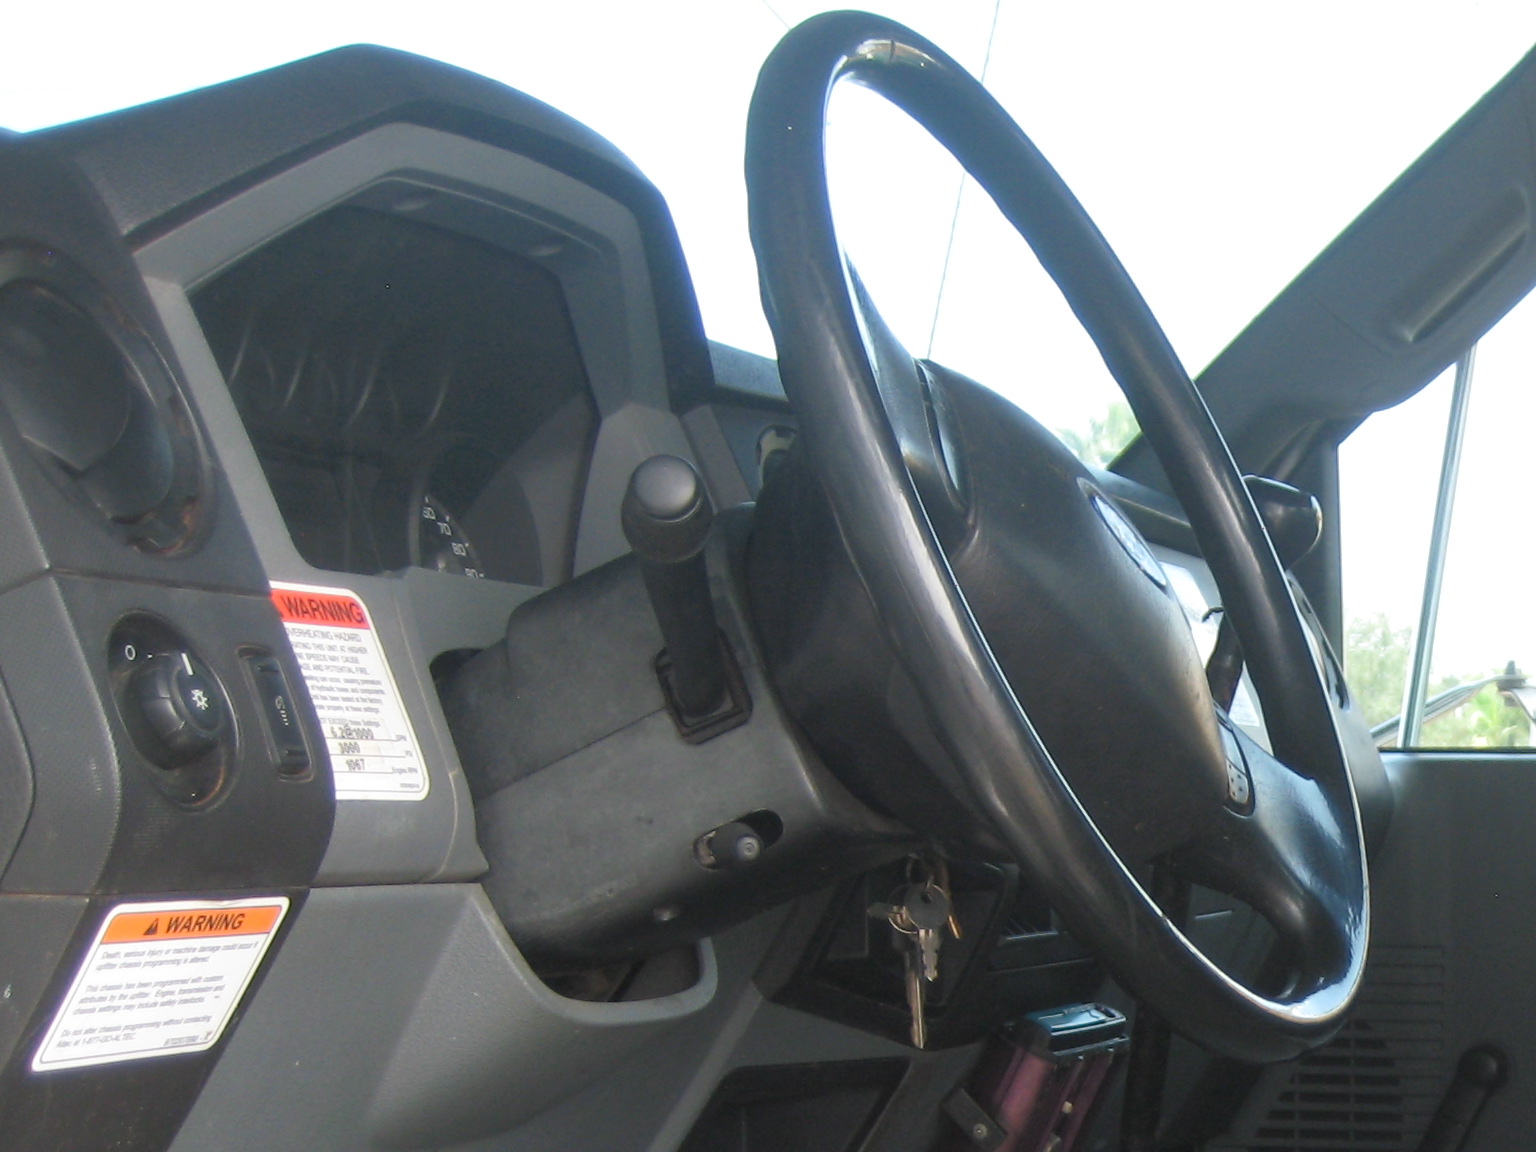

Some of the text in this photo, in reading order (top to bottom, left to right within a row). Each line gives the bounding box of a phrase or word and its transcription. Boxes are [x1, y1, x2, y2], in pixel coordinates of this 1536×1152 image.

[437, 522, 452, 536] 70
[281, 596, 364, 623] WARNING
[333, 632, 361, 642] HAZARD
[312, 643, 325, 651] THIS
[347, 647, 368, 655] HIGHER
[338, 742, 360, 754] 3000
[346, 758, 365, 771] 1067
[166, 913, 245, 934] WARNING
[197, 945, 220, 953] damage
[141, 958, 182, 968] programming
[152, 978, 190, 988] programmed
[122, 1021, 161, 1031] programming
